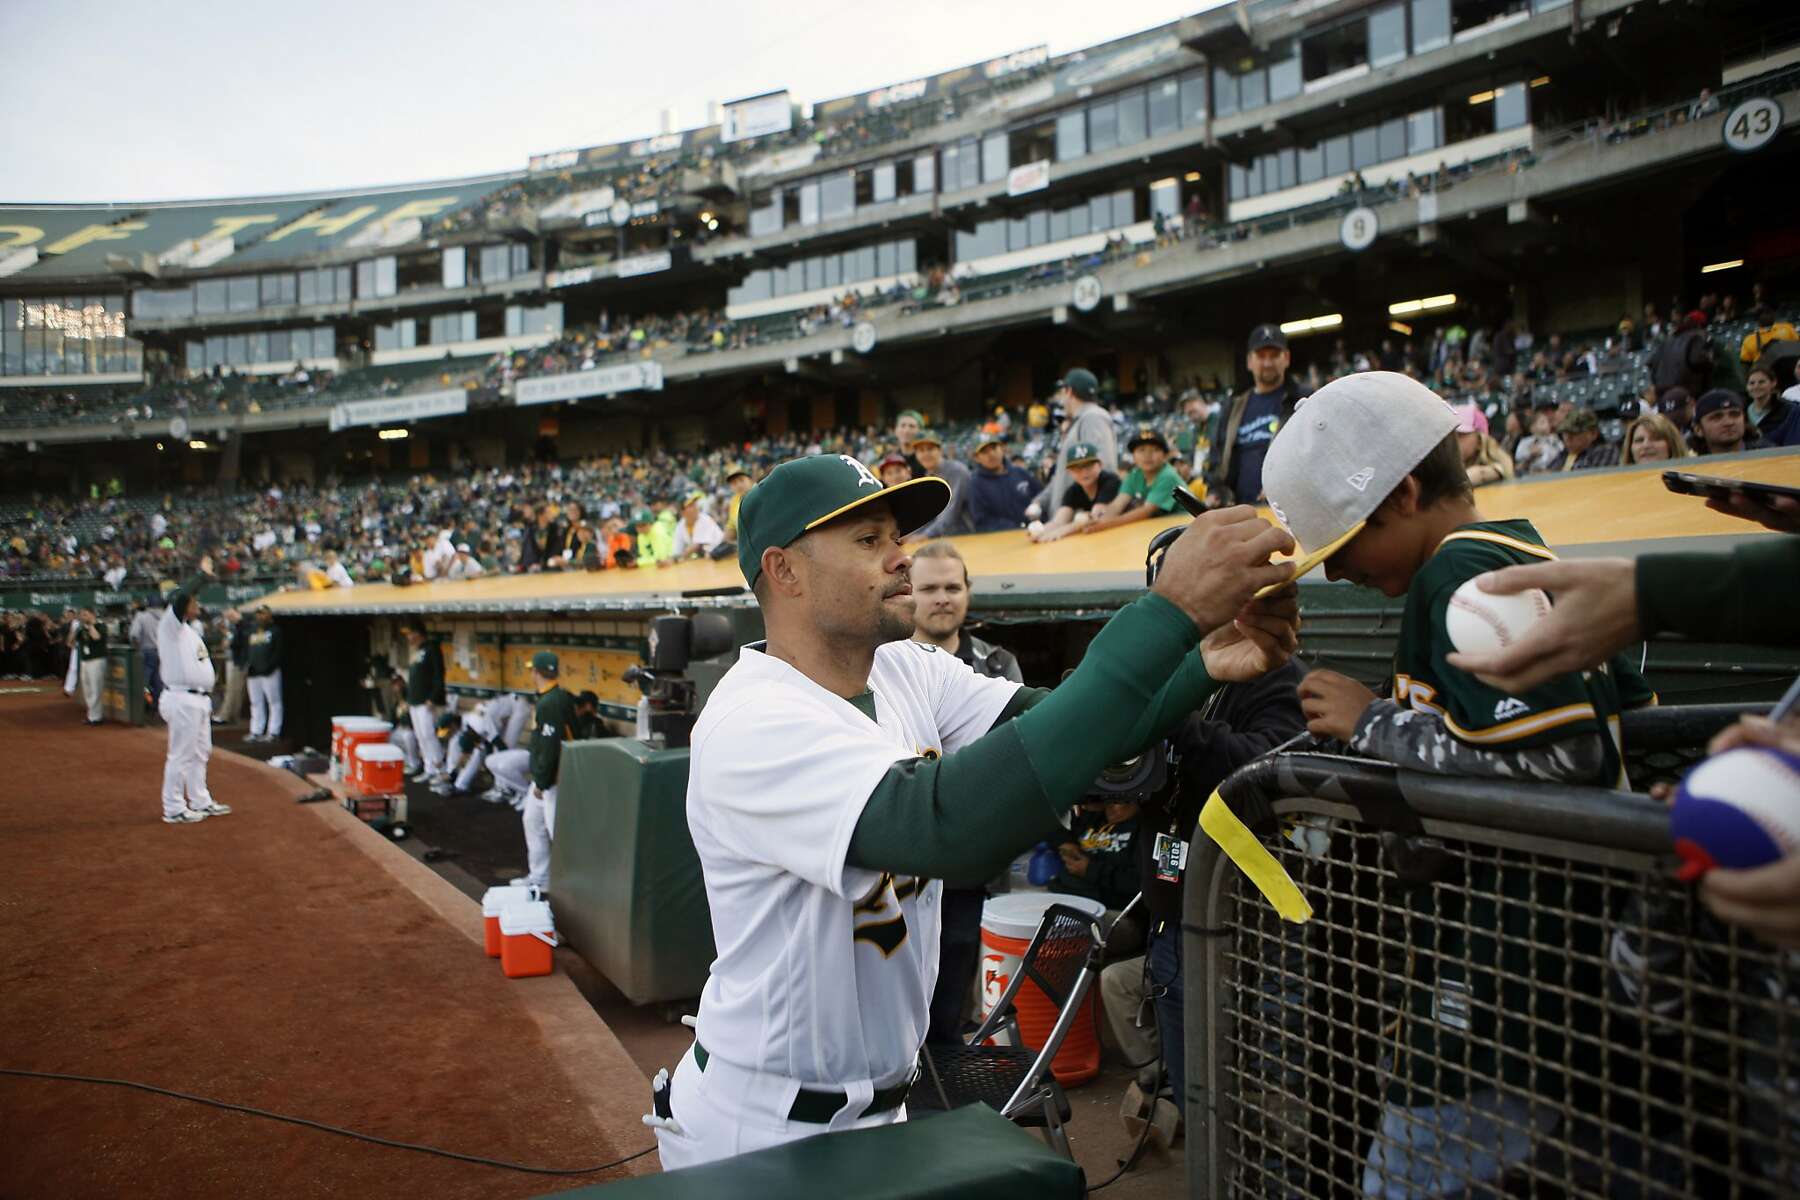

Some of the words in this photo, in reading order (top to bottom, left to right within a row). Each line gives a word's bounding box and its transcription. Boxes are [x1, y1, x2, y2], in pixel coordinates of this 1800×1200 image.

[1731, 108, 1771, 139] 43
[1353, 217, 1366, 241] 9
[1170, 842, 1180, 867] 2016
